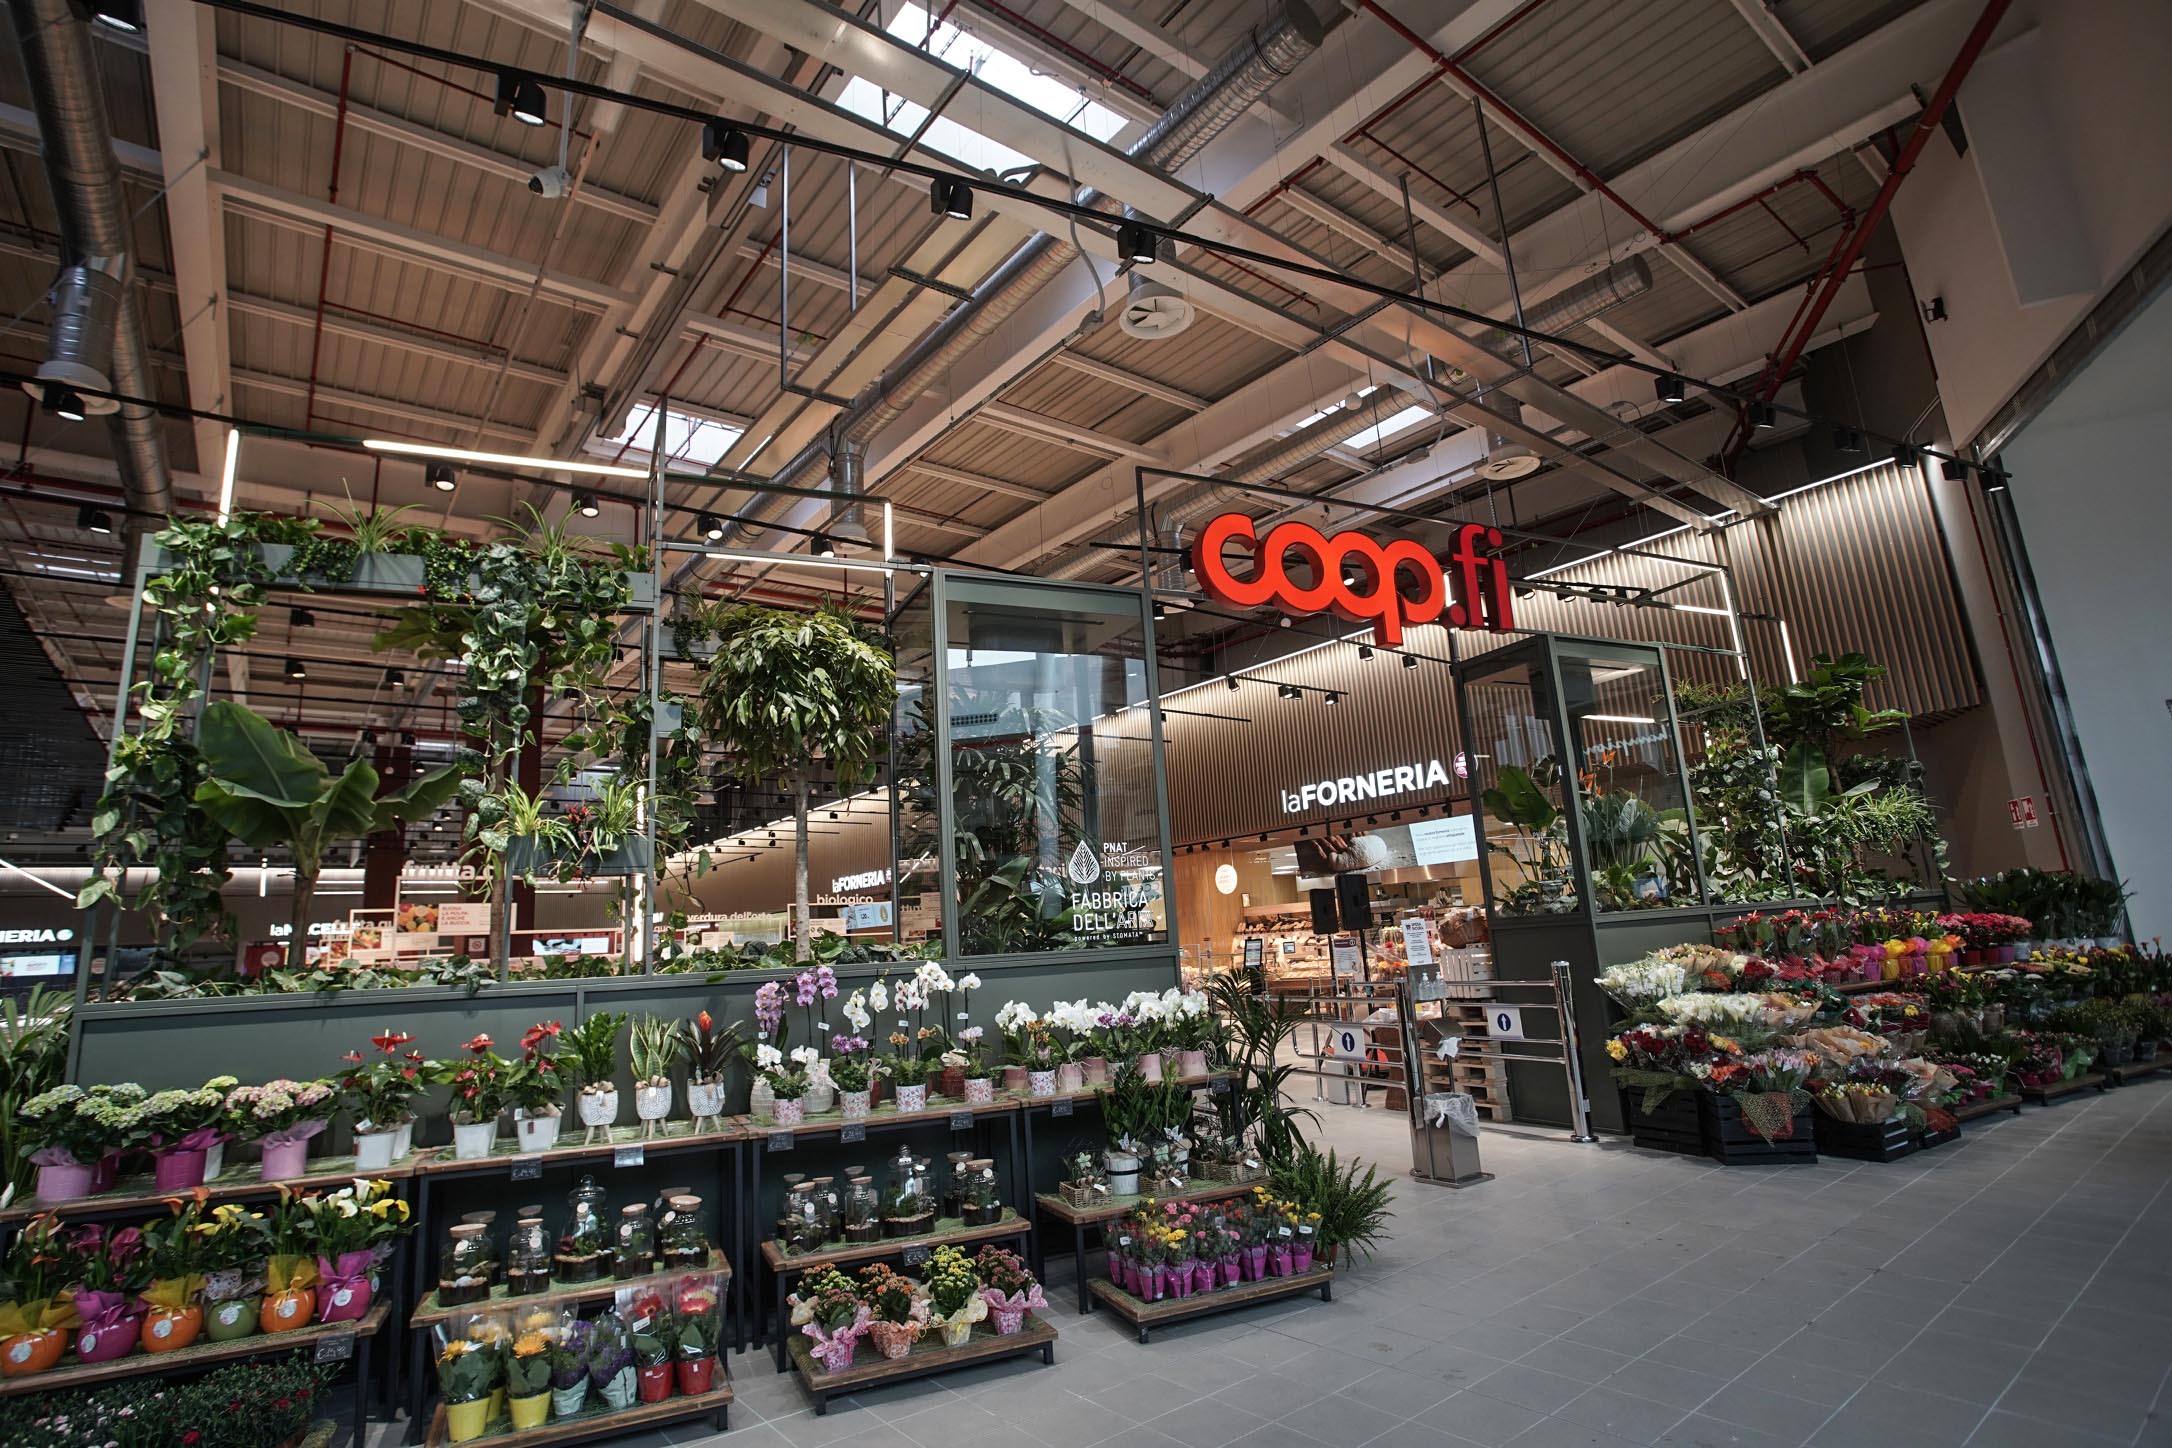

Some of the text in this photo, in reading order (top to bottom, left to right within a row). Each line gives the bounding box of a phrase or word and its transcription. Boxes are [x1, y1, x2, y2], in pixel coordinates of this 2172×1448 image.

[1192, 512, 1515, 649] coop.fi
[1281, 759, 1450, 815] laFORNERIA
[1103, 842, 1128, 853] PNAT
[831, 869, 886, 894] laFORNERIA
[1105, 870, 1117, 882] BY
[816, 893, 874, 906] biologico
[1072, 891, 1150, 910] FABBRICA
[1073, 933, 1100, 942] powered
[1102, 933, 1111, 942] by
